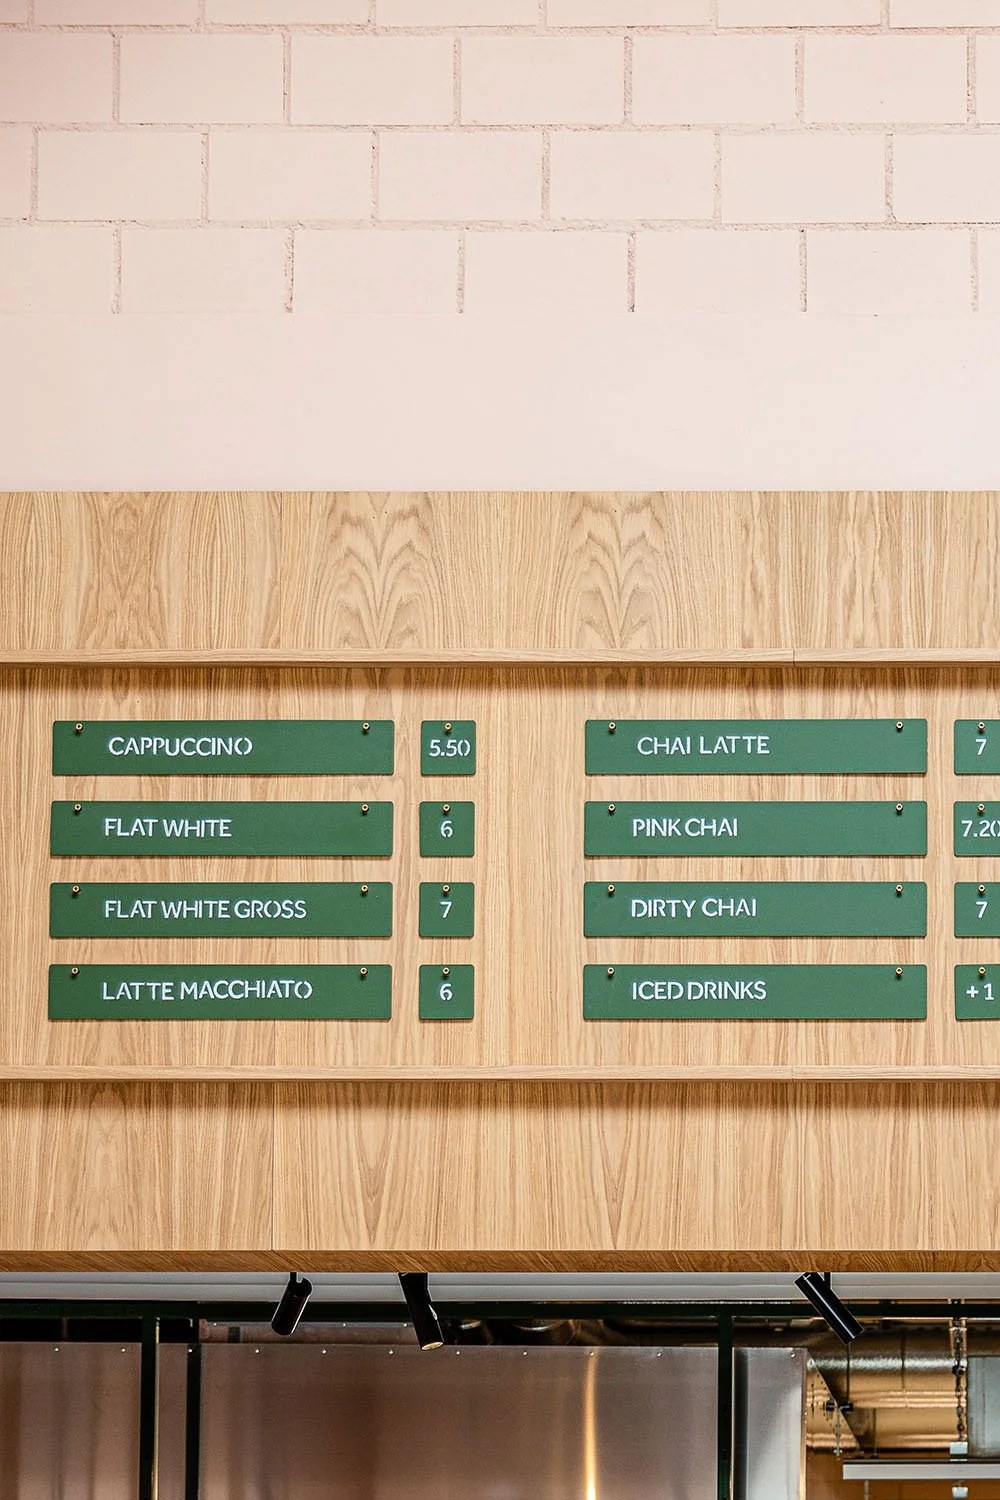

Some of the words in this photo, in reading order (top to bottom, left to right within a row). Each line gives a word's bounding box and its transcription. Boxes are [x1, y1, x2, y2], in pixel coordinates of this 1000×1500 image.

[108, 736, 253, 757] CAPPUCCINO
[429, 739, 471, 757] 5.50
[637, 736, 691, 756] CHAI
[699, 735, 770, 754] LATTE
[975, 738, 987, 756] 7
[105, 817, 159, 837] FLAT
[162, 818, 232, 838] WHITE
[440, 820, 453, 838] 6
[632, 817, 682, 837] PINK
[684, 817, 738, 837] CHAI
[105, 899, 158, 919] FLAT
[160, 899, 231, 919] WHITE
[233, 899, 307, 919] GROSS
[440, 901, 452, 918] 7
[631, 898, 697, 918] DIRTY
[701, 897, 757, 917] CHAI
[975, 901, 988, 919] 7
[102, 981, 175, 1001] LATTE
[180, 979, 313, 1000] MACCHIATO
[439, 983, 453, 1001] 6
[632, 981, 684, 1000] ICED
[687, 980, 767, 1001] DRINKS
